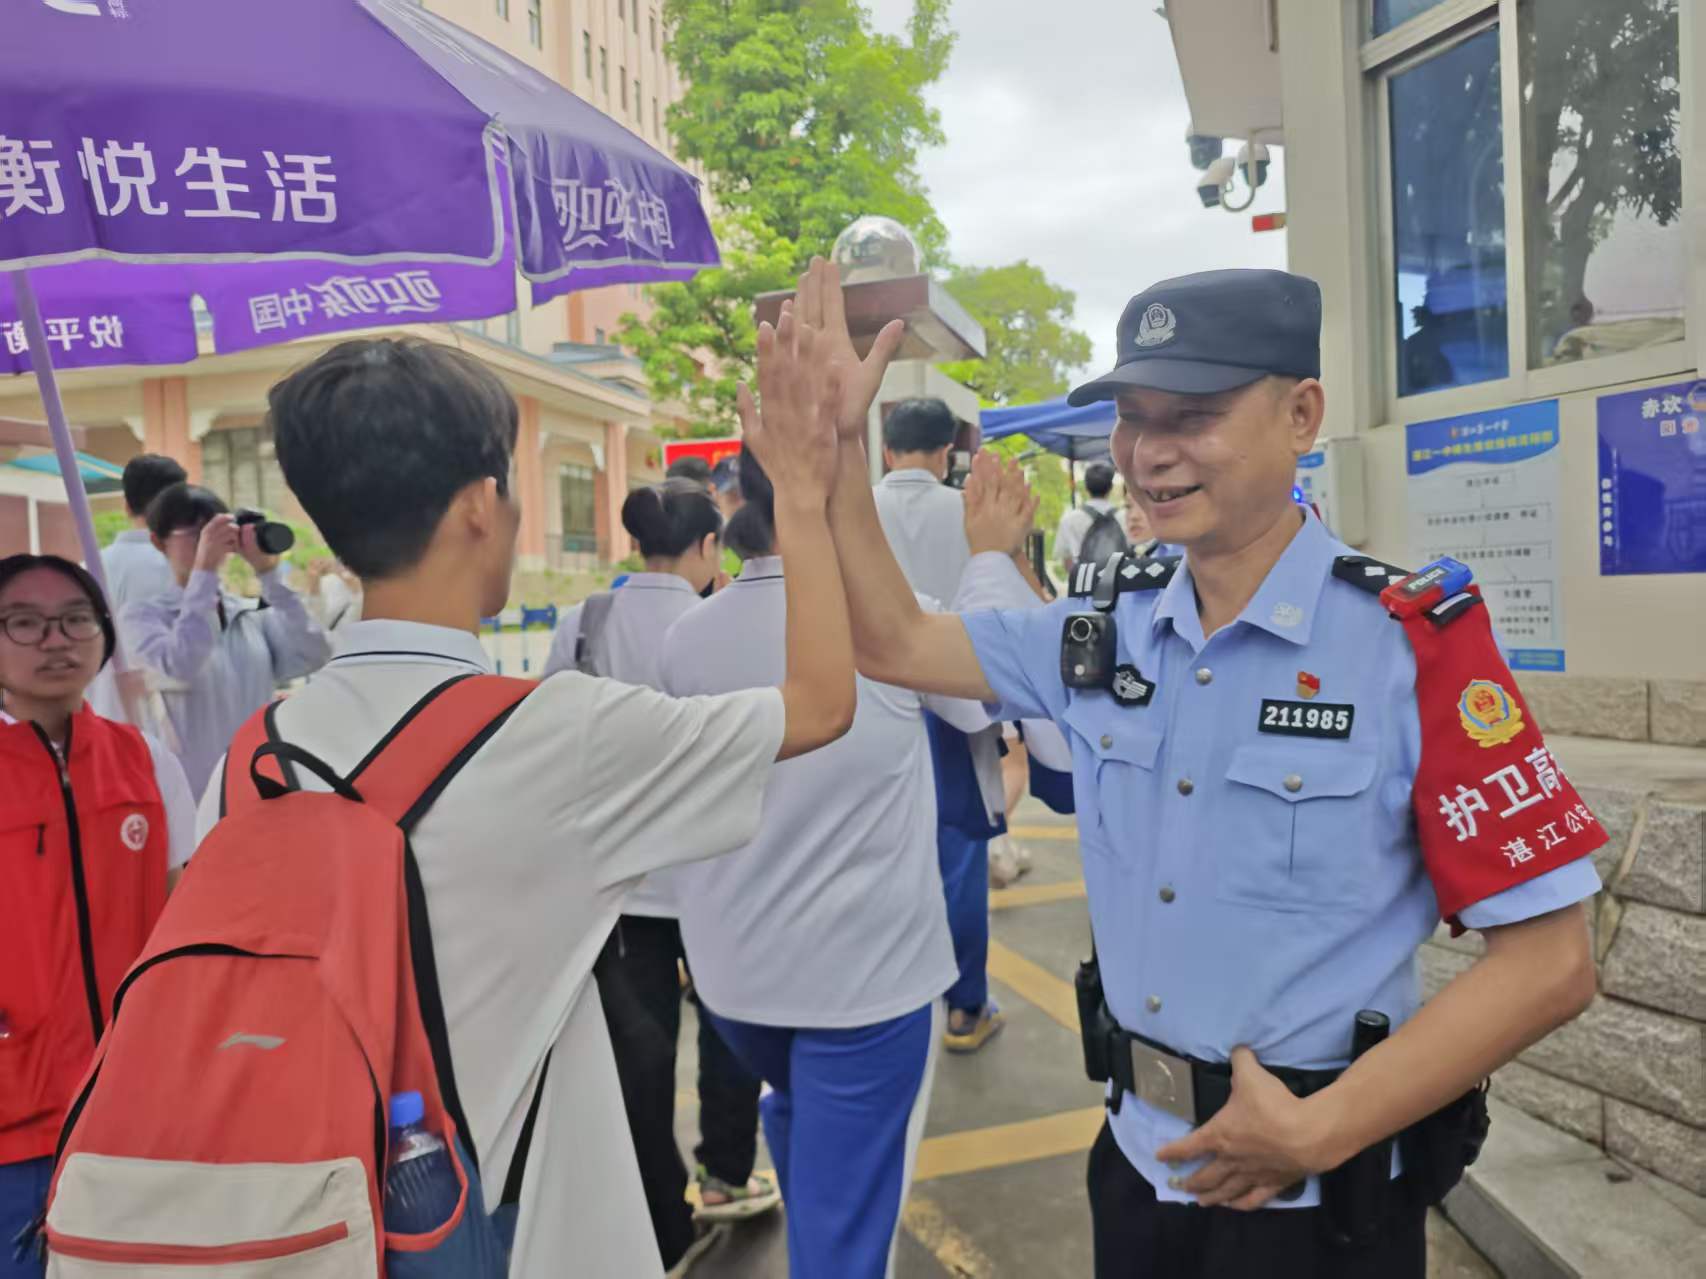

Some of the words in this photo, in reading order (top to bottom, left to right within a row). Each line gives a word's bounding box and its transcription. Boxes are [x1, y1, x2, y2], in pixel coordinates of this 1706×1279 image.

[1263, 705, 1350, 731] 211985
[1438, 747, 1568, 842] 护卫高
